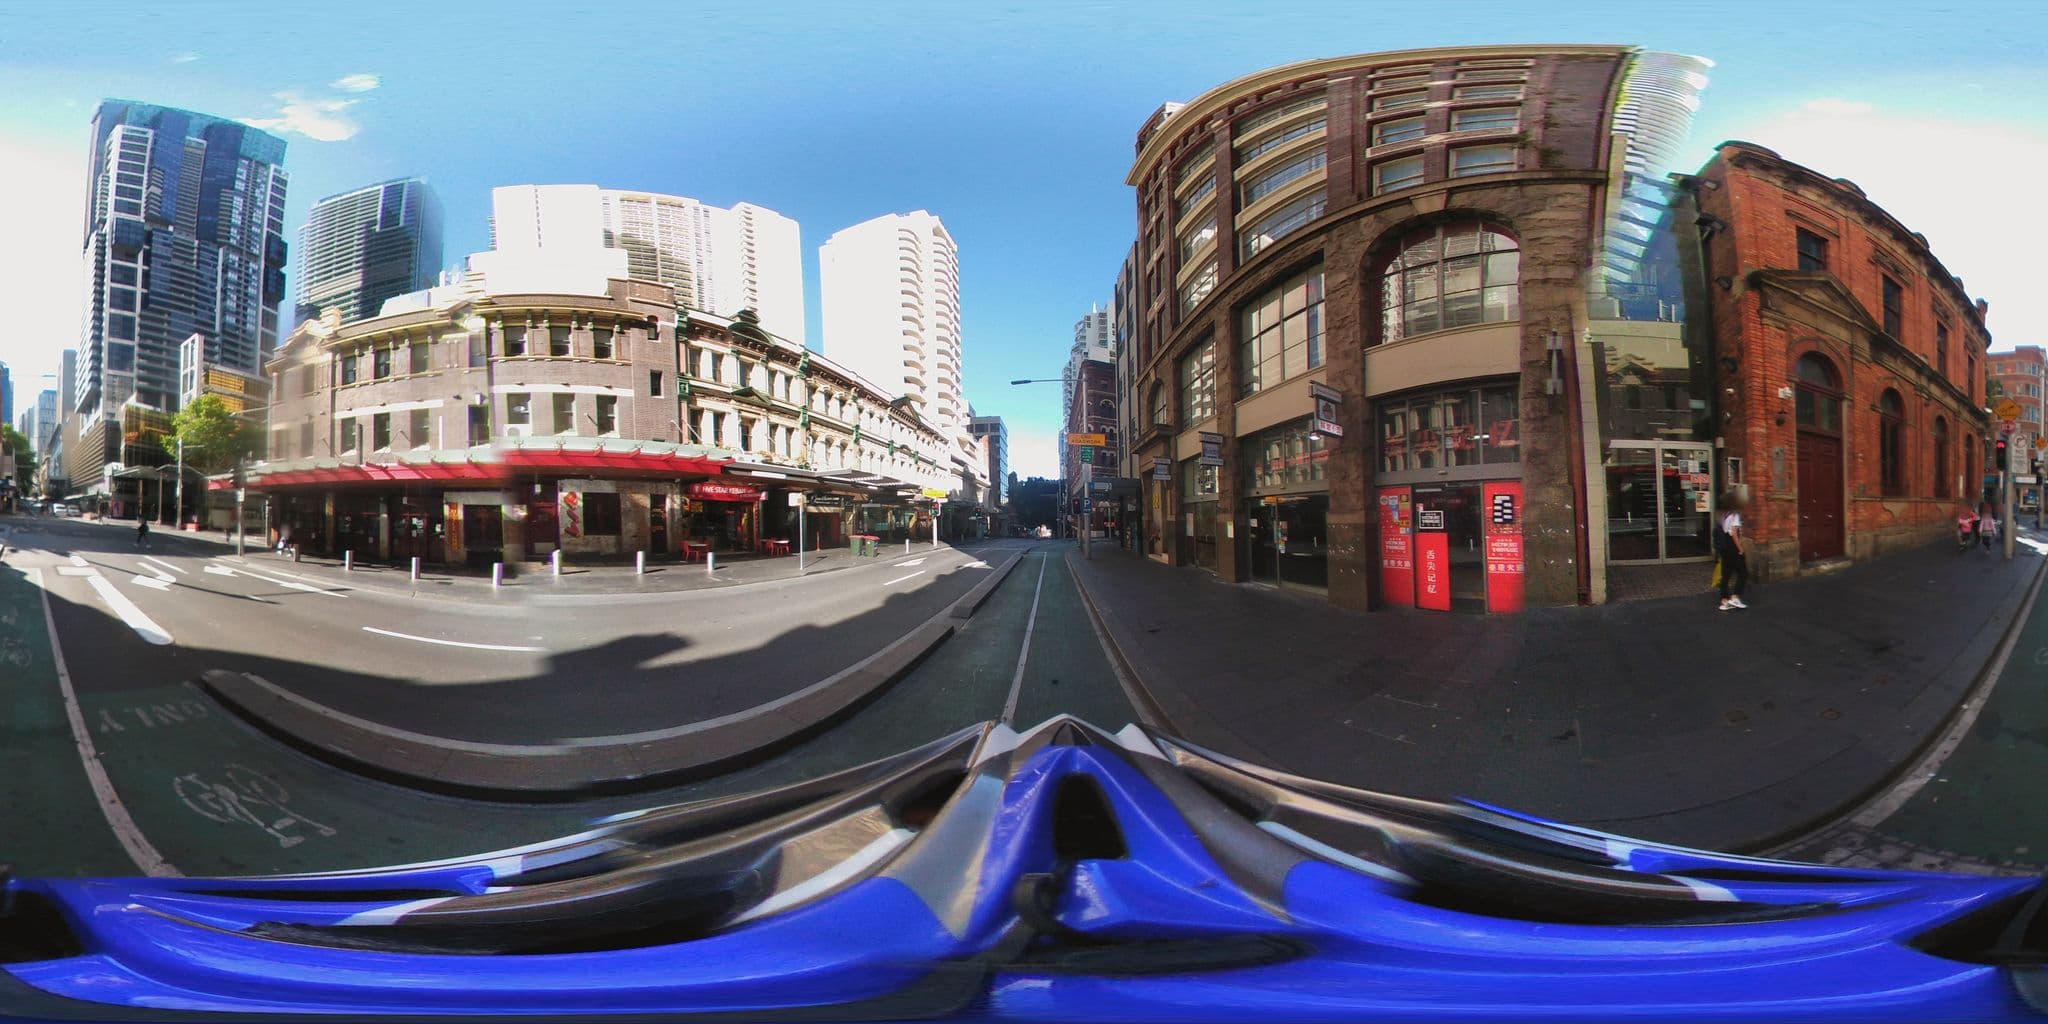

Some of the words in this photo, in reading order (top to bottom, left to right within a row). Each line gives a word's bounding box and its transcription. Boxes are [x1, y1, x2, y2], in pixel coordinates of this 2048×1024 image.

[1084, 499, 1091, 508] P
[1426, 549, 1437, 594] 舌尖记忆
[99, 702, 208, 732] ONLY
